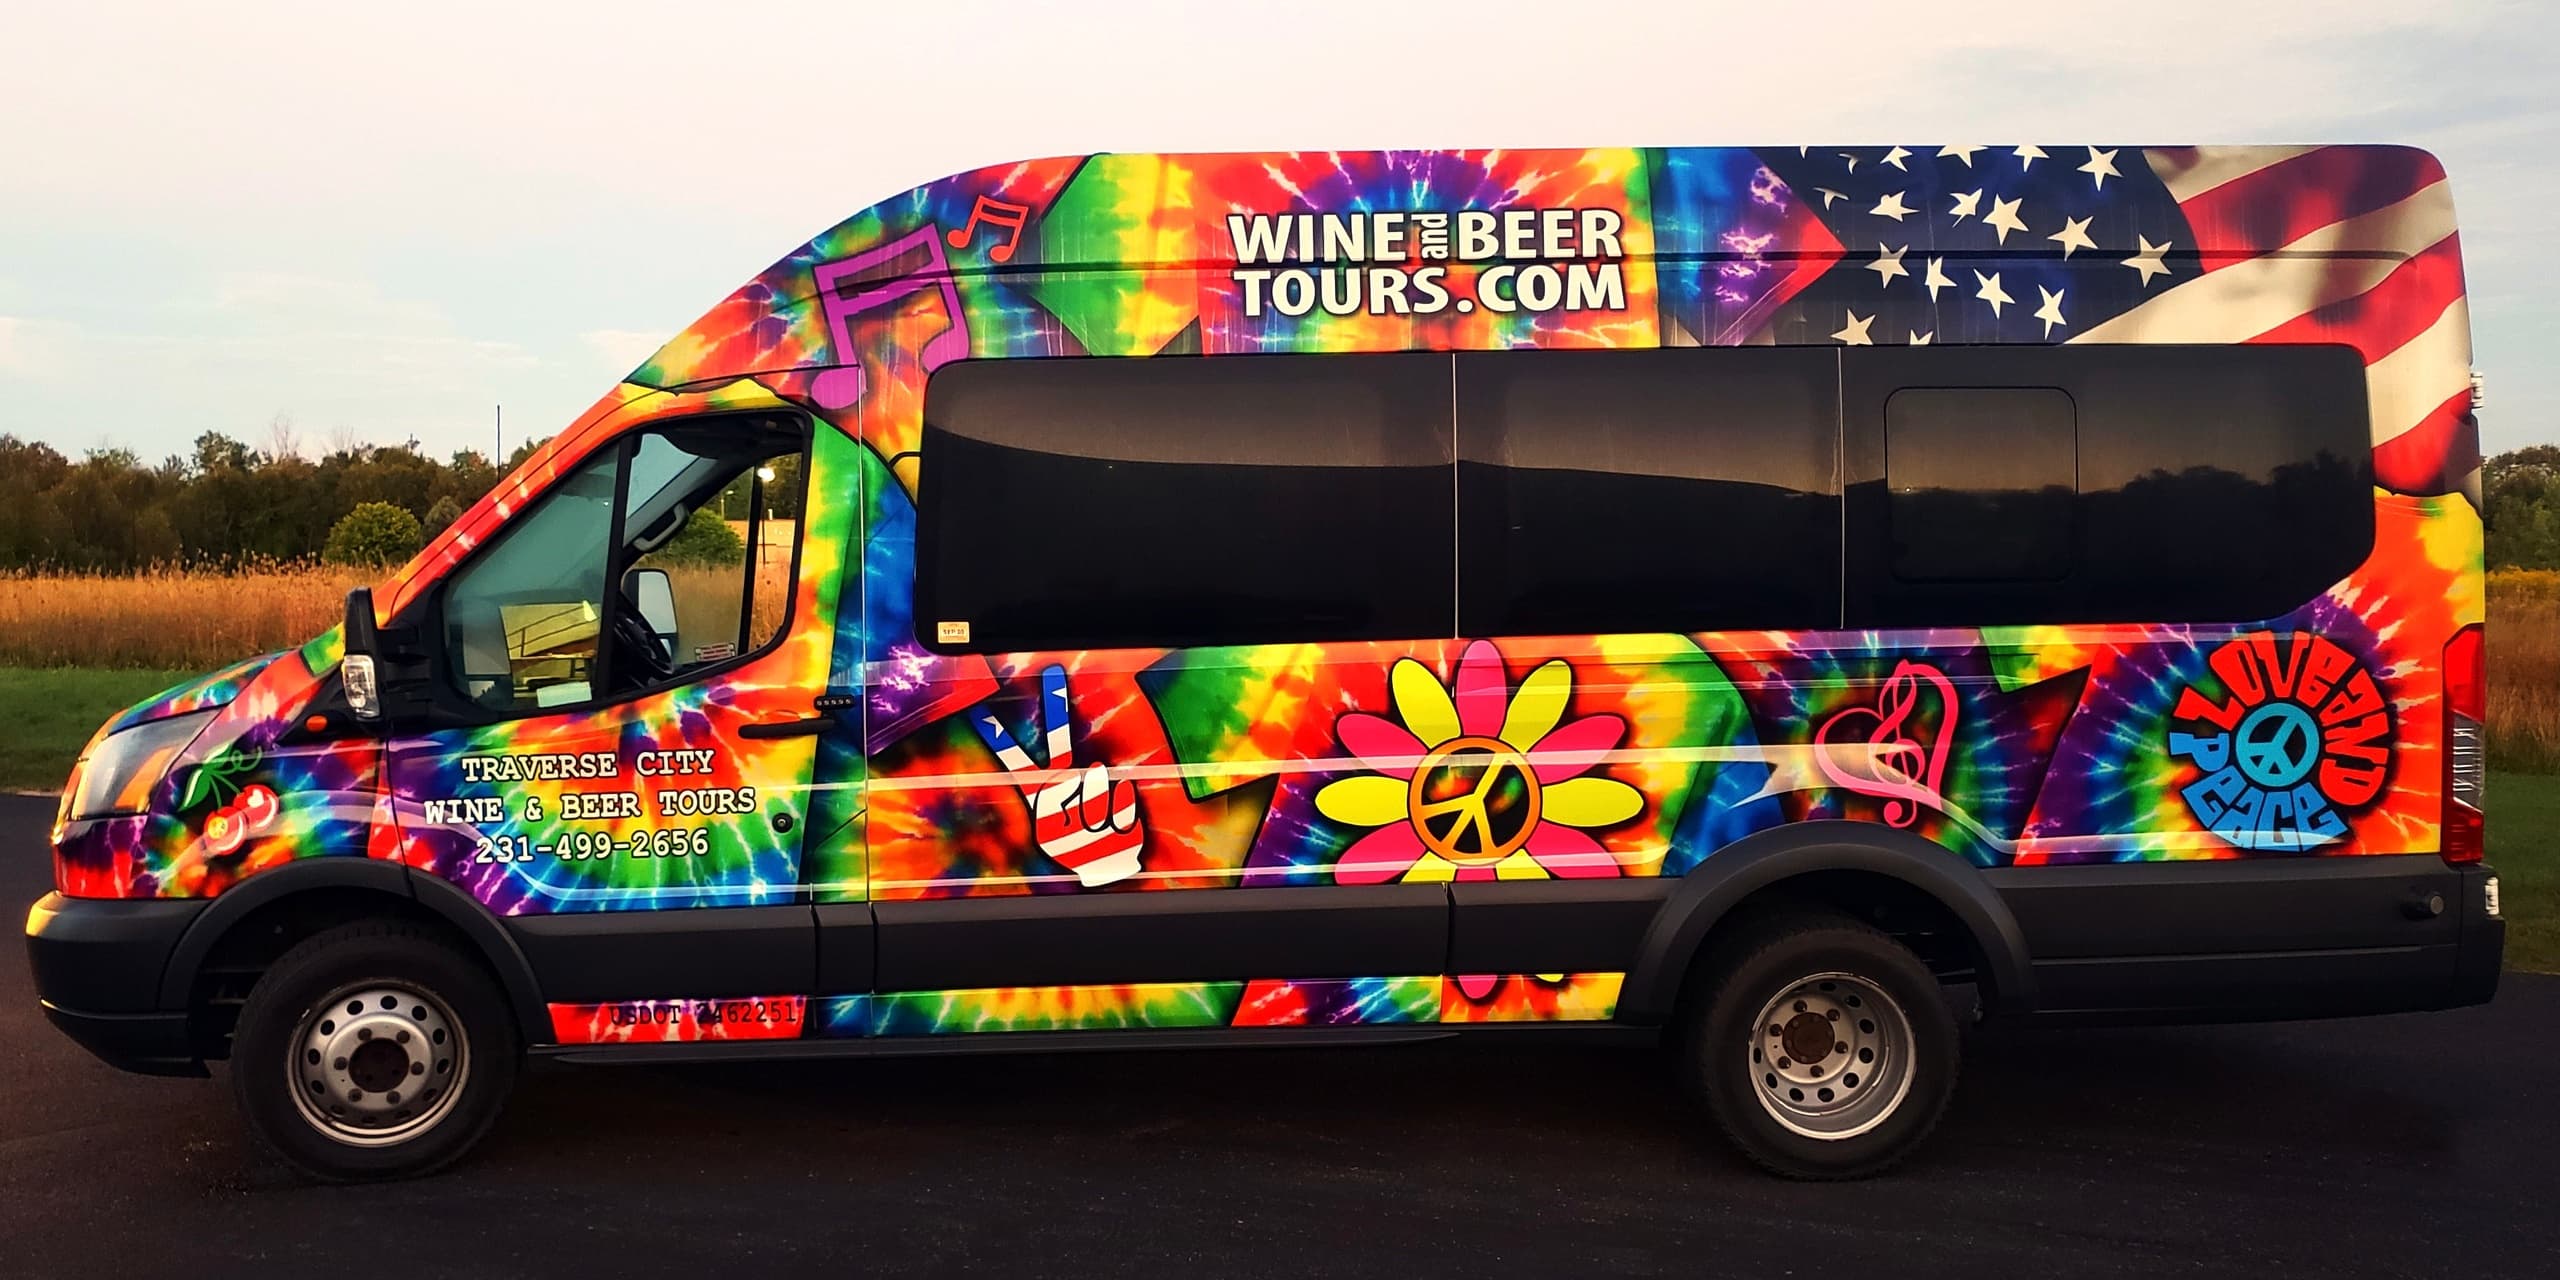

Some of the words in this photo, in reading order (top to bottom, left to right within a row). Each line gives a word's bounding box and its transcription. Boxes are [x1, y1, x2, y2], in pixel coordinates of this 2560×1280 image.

[1227, 212, 1406, 263] WINE
[1411, 212, 1448, 260] and
[1457, 208, 1622, 260] BEER
[1233, 263, 1625, 317] TOURS.COM
[461, 752, 617, 782] TRAVERSE
[636, 749, 714, 777] CITY
[424, 797, 504, 825] WINE
[525, 797, 543, 821] &
[561, 793, 641, 819] BEER
[659, 787, 756, 816] TOURS
[475, 828, 709, 865] 231-499-2656
[609, 1004, 681, 1027] USDOT
